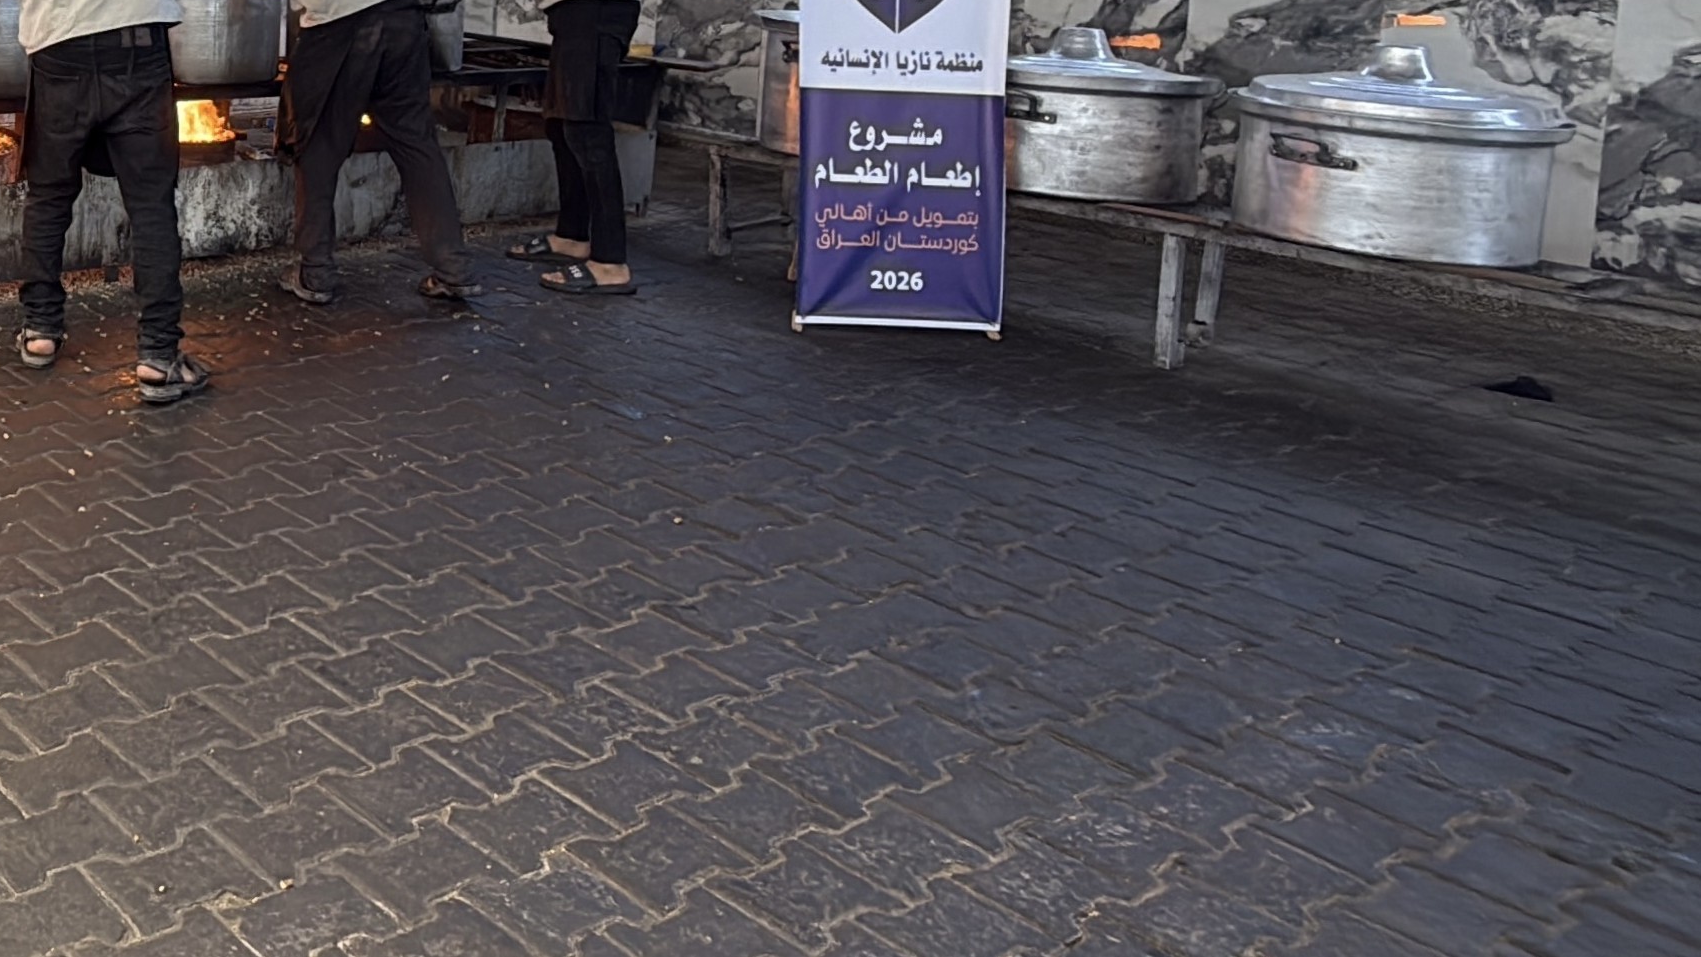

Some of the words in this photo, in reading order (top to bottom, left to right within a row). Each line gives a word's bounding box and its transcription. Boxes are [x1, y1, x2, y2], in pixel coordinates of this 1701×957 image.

[896, 50, 931, 76] نازيا
[936, 50, 984, 73] منظمة
[848, 117, 943, 151] مشروع
[814, 157, 898, 188] الطعام
[906, 161, 981, 197] إطعام
[815, 202, 873, 228] أهالي
[876, 207, 909, 226] من
[912, 206, 979, 230] بتمويل
[816, 227, 880, 250] العراق
[884, 231, 979, 255] كوردستان
[870, 270, 924, 291] 2026
